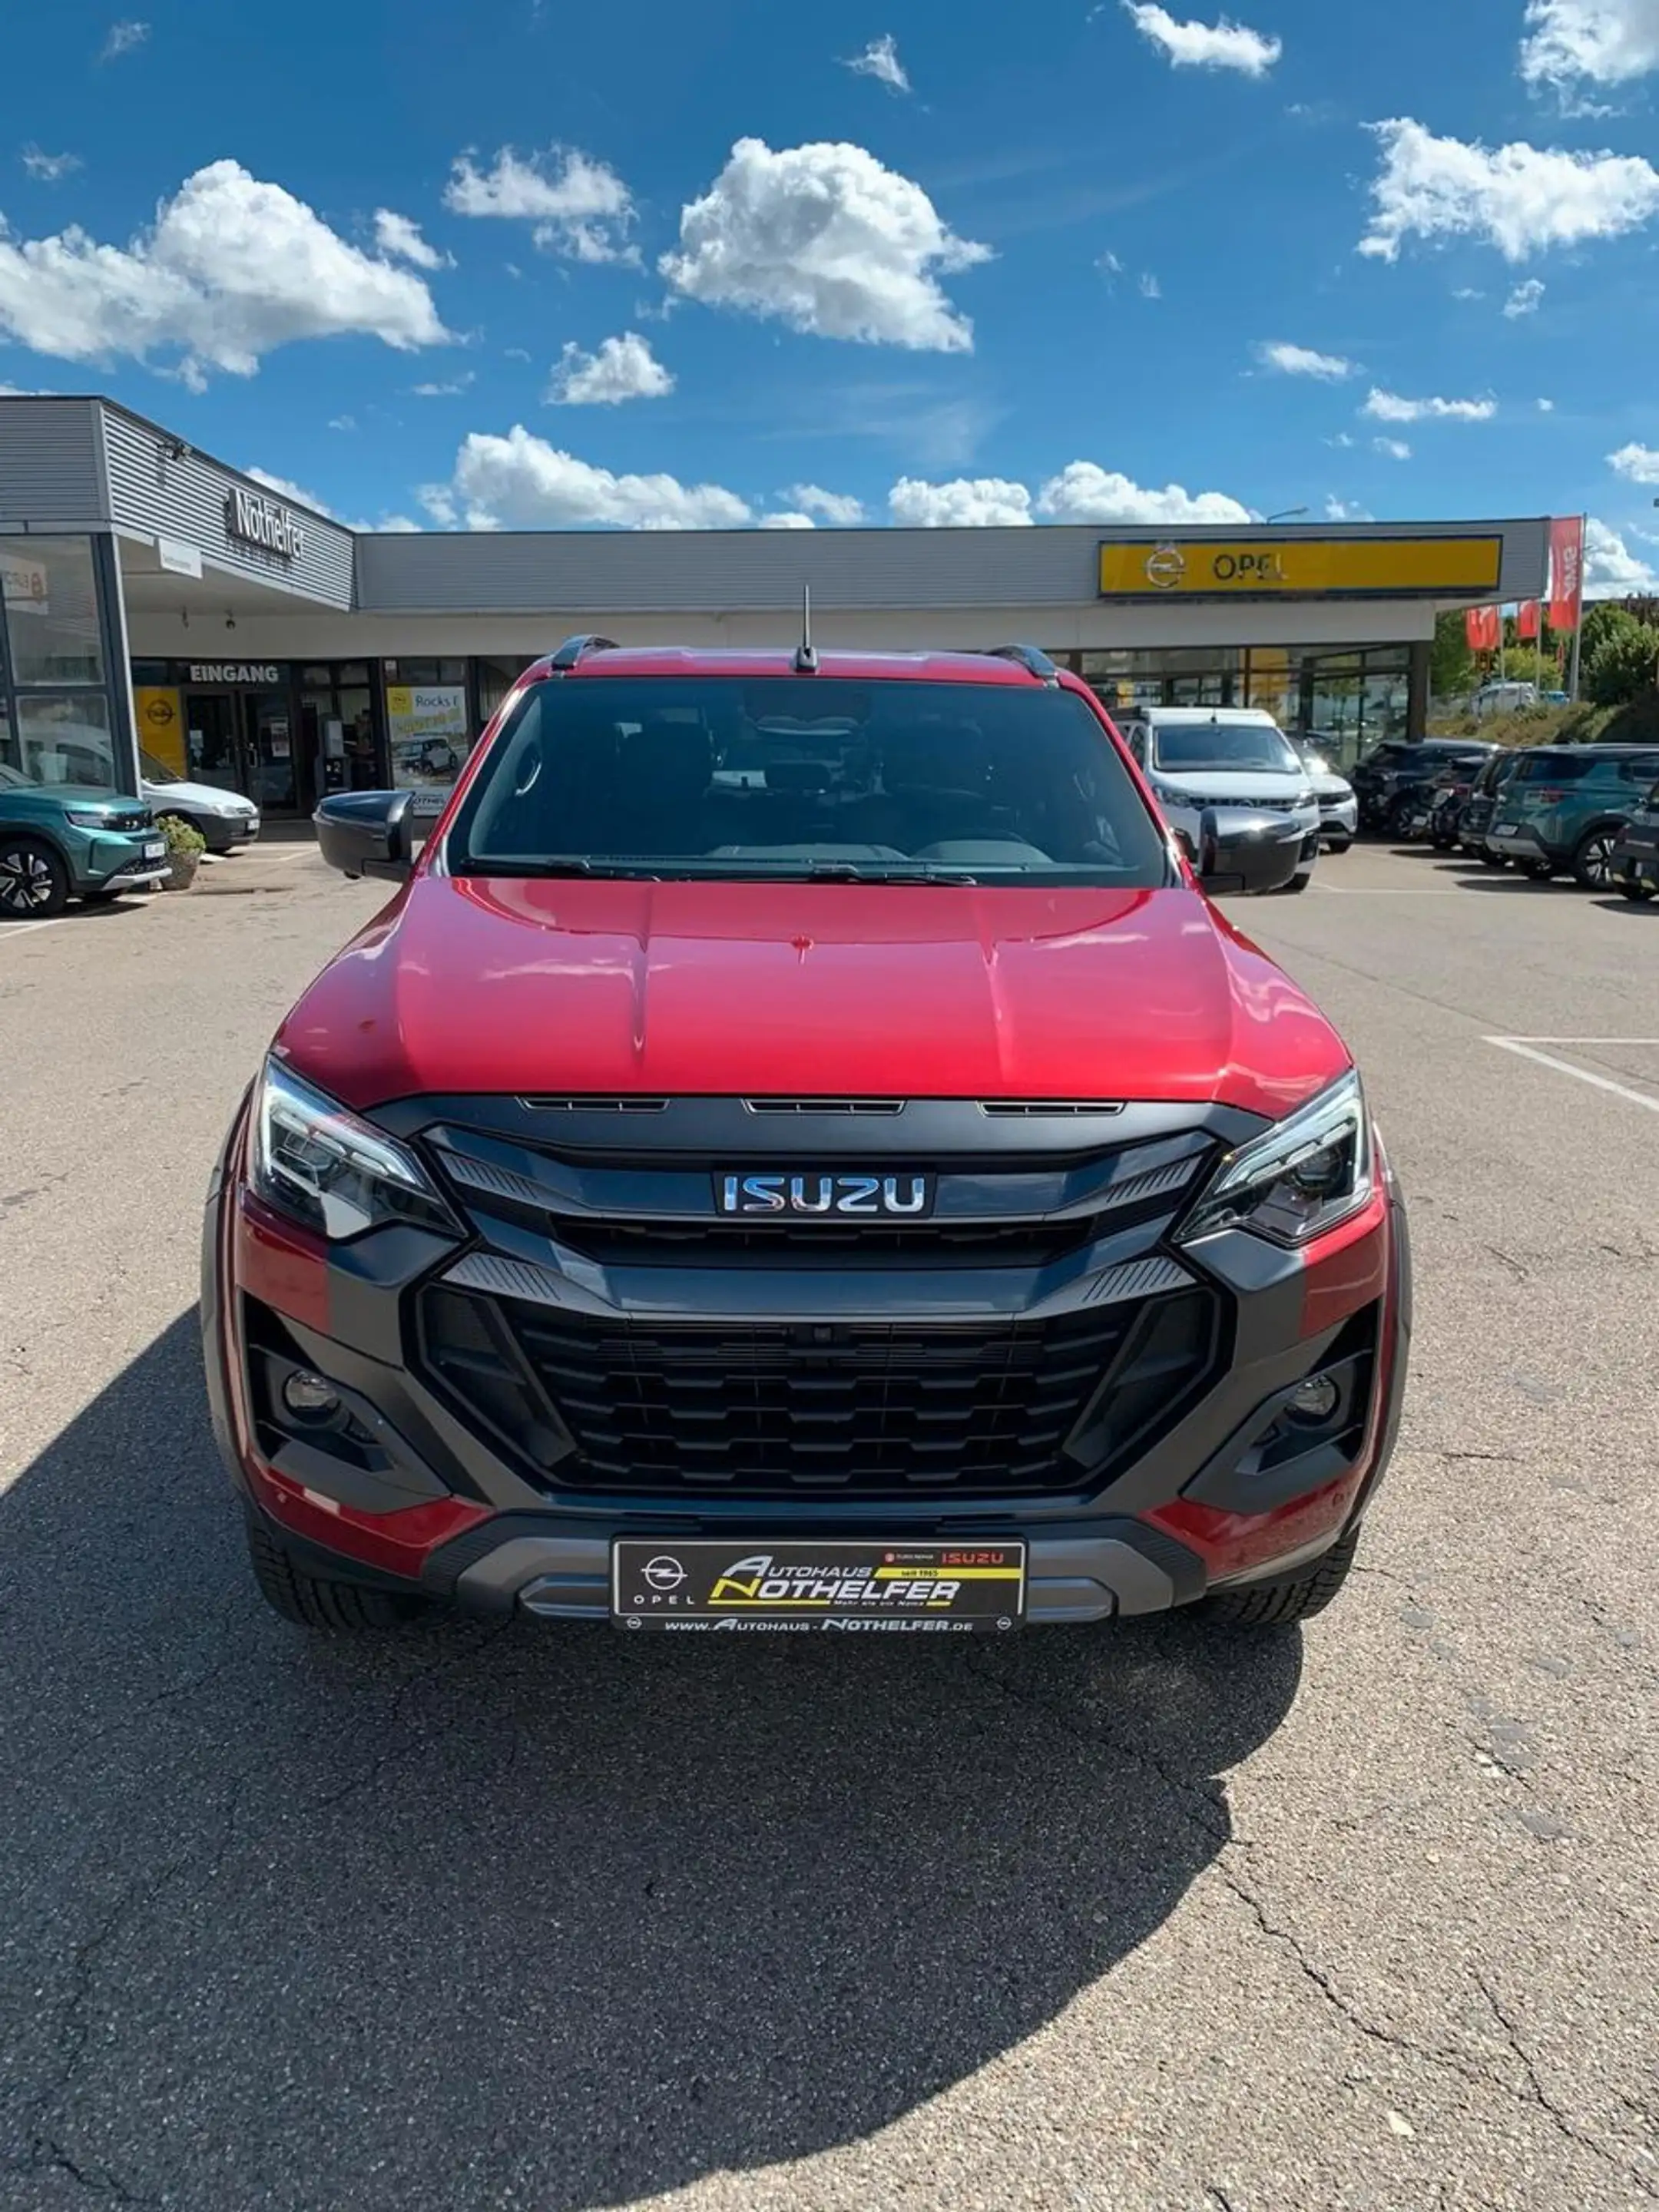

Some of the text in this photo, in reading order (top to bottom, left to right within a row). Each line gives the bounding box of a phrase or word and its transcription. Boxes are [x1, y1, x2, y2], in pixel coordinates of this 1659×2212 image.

[233, 488, 303, 558] Nothelfer
[1214, 553, 1289, 581] OPEL
[190, 664, 279, 683] EINGANG
[416, 694, 450, 707] Rocks
[724, 1177, 925, 1212] ISUZU
[722, 1555, 873, 1578] AUTOHAUS
[942, 1551, 1004, 1565] ISUZU
[634, 1594, 694, 1604] OPEL
[710, 1578, 960, 1599] NOTHELFER
